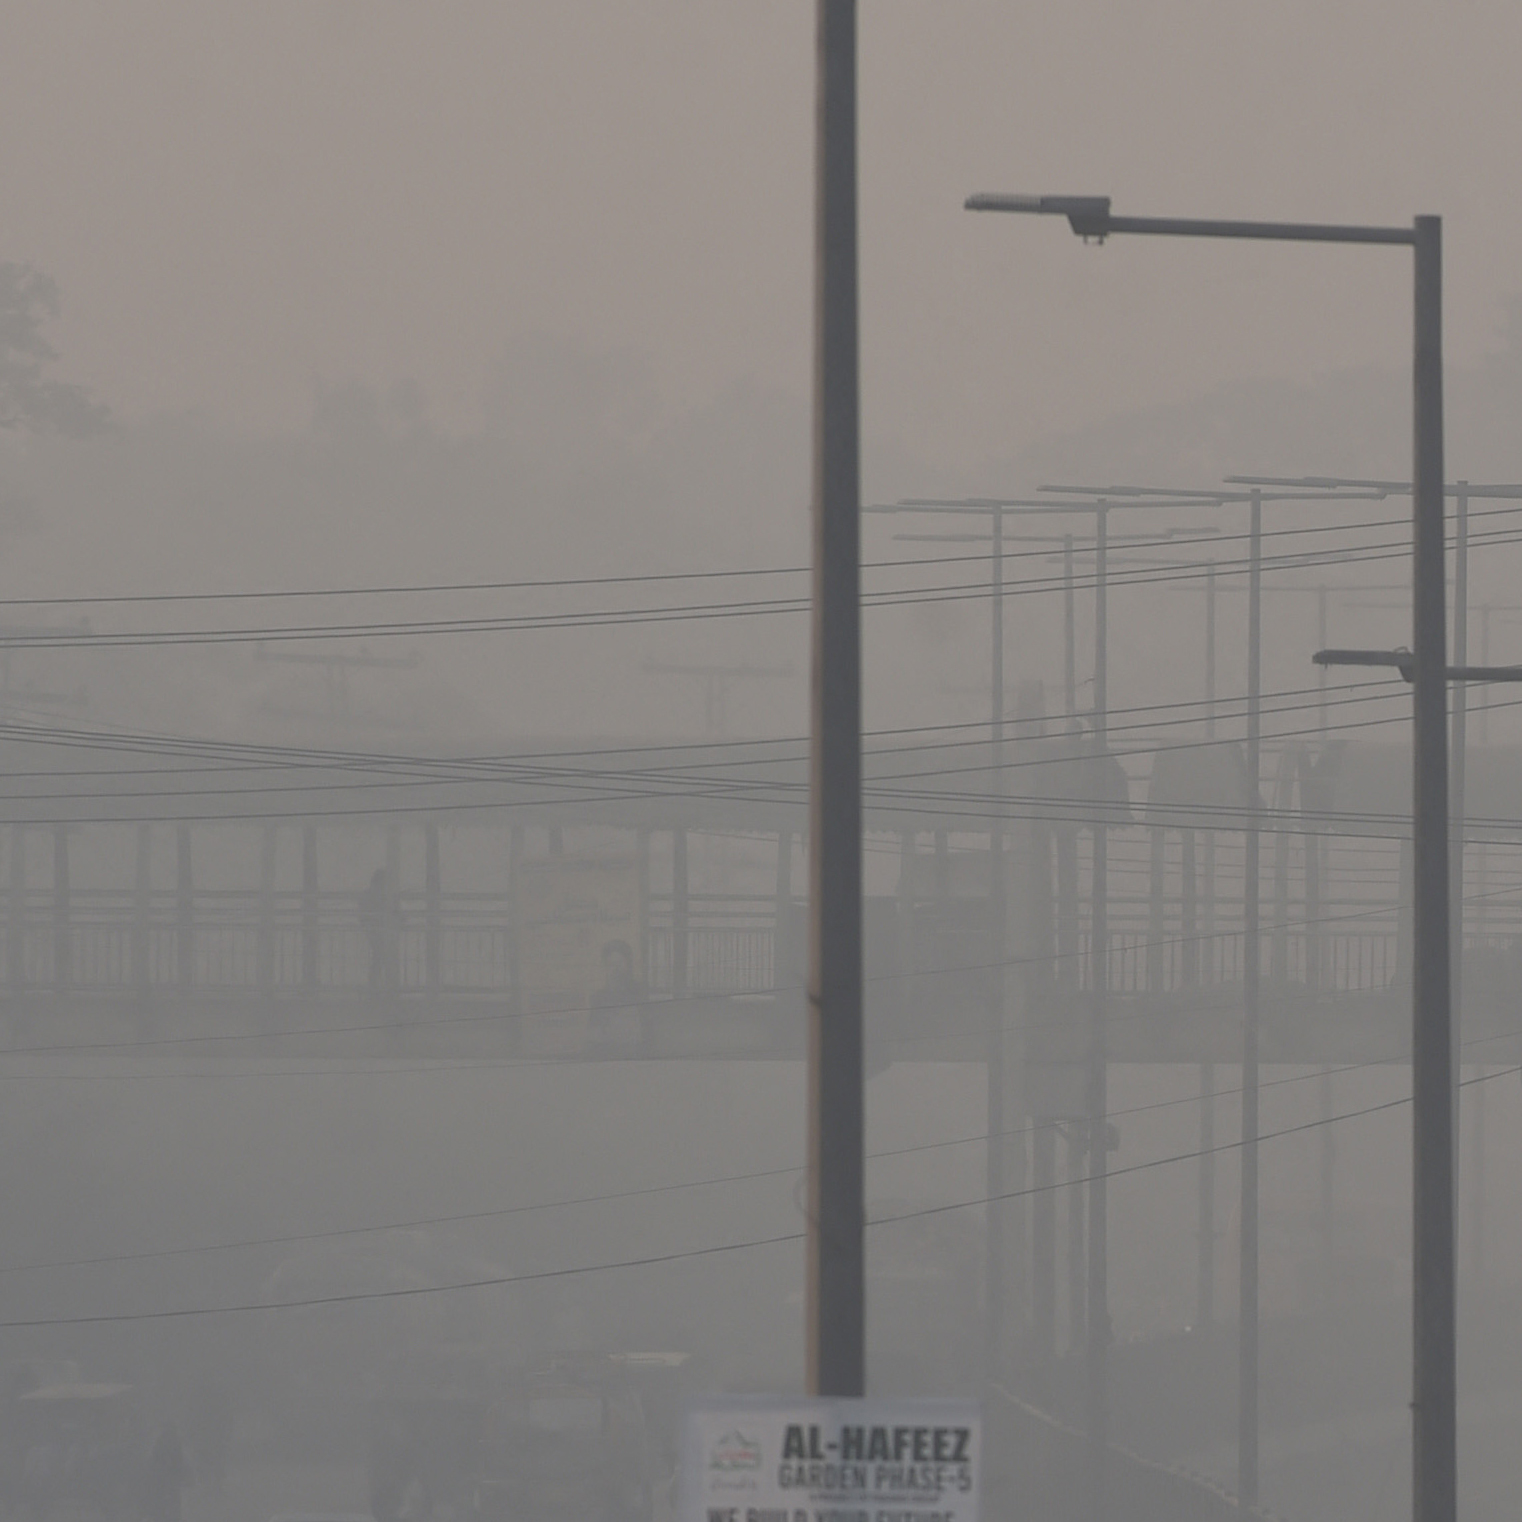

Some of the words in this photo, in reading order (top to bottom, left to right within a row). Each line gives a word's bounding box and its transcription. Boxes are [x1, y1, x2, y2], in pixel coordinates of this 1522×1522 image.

[782, 1423, 970, 1462] AL-HAFEEZ
[778, 1464, 867, 1490] GARDEN
[875, 1466, 972, 1493] PHASE-5
